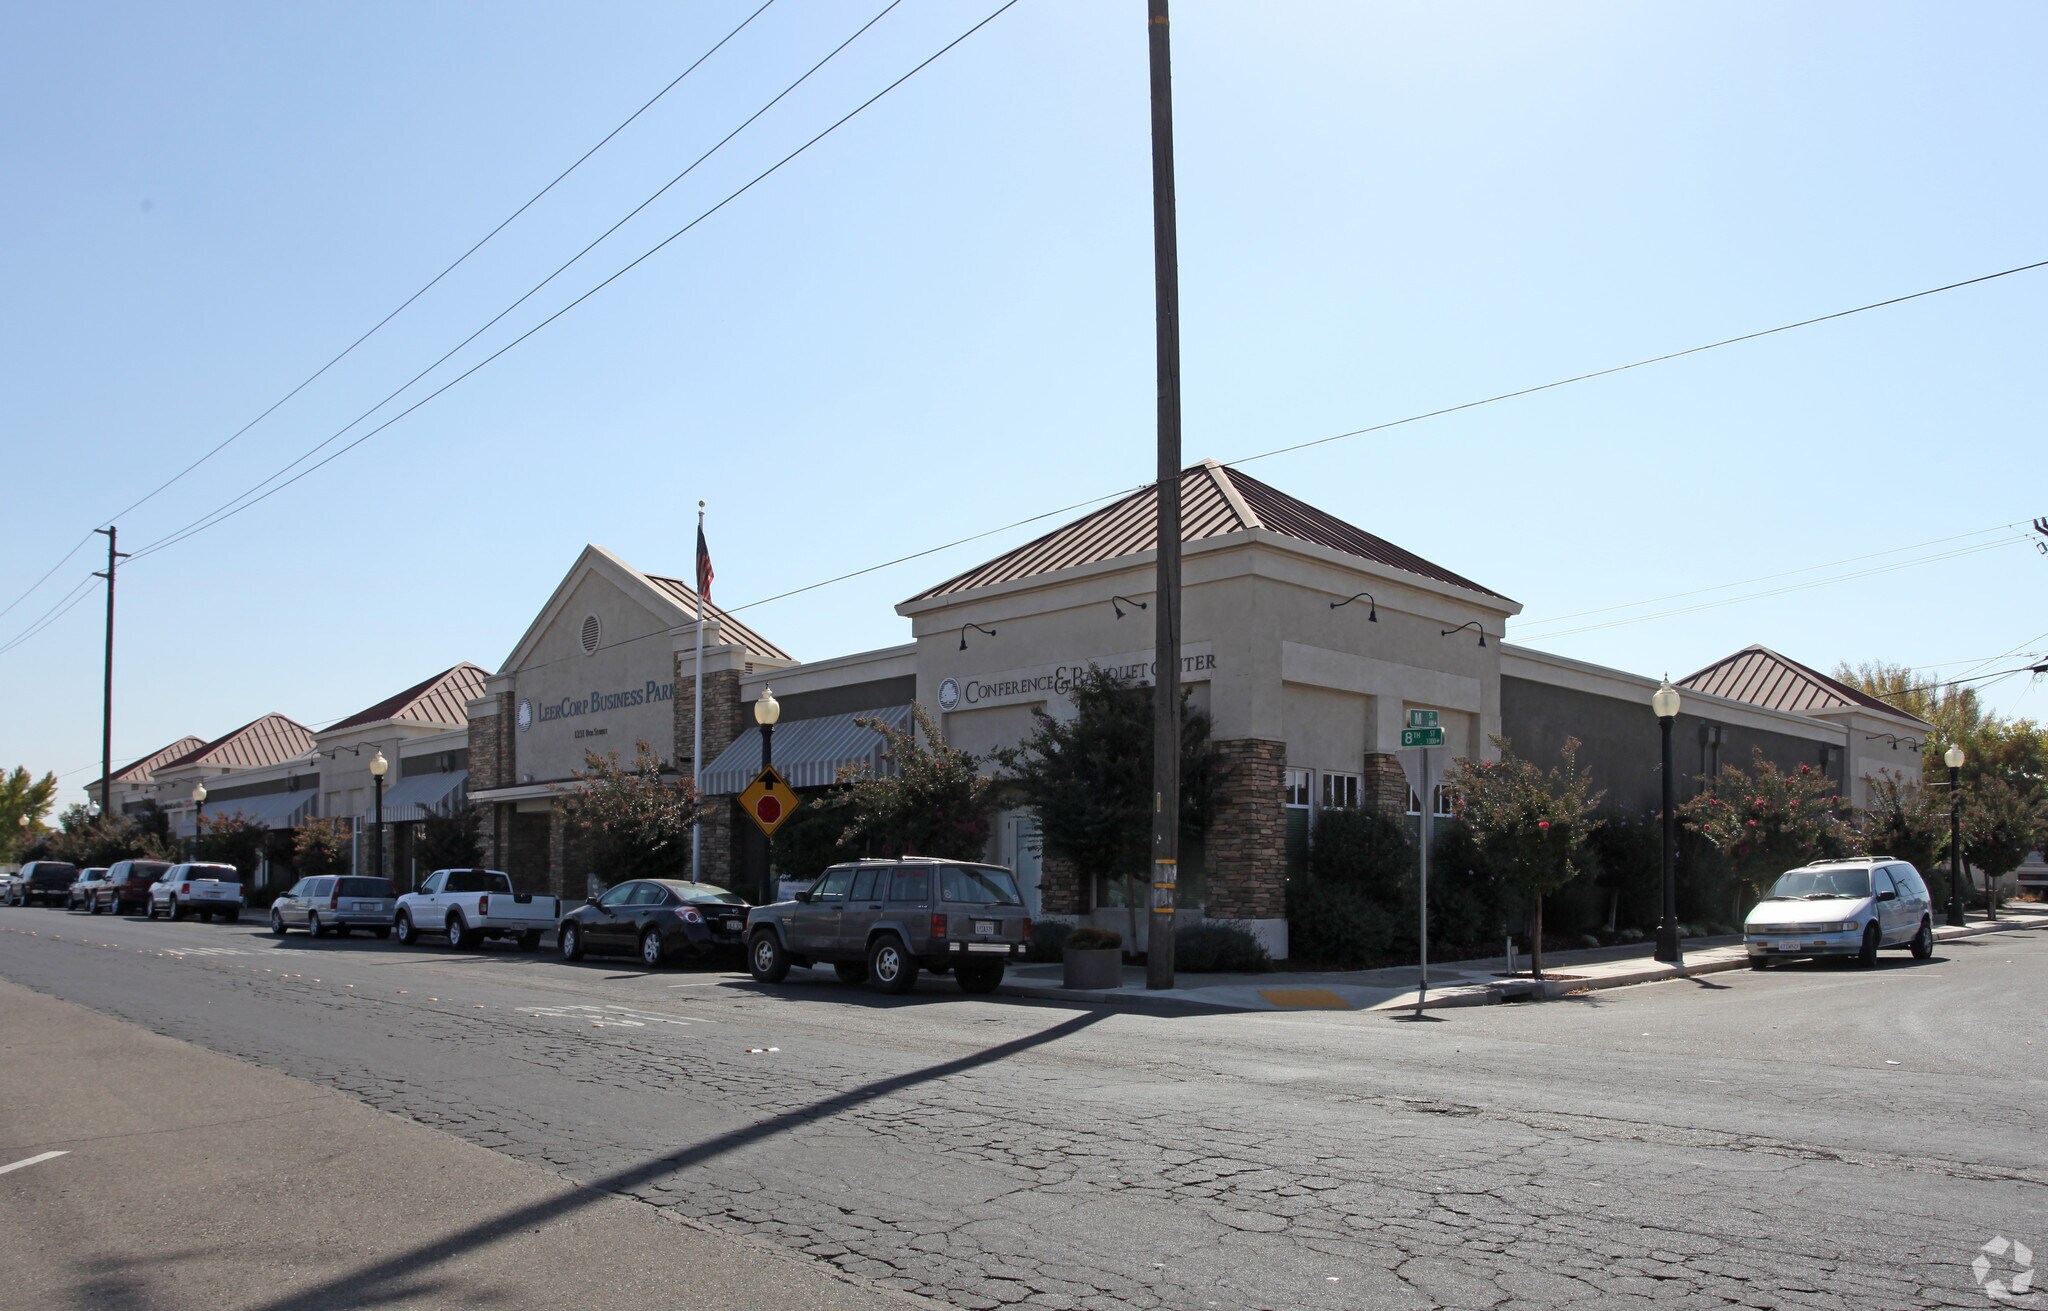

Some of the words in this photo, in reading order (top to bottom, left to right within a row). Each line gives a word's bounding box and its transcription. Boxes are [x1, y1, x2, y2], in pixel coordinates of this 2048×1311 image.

[538, 696, 588, 722] LEERCORP
[590, 688, 643, 713] BUSINESS
[645, 680, 676, 703] PARK
[965, 676, 1053, 703] CONFERENCE
[1054, 666, 1070, 695] &
[1405, 732, 1421, 744] 8TH
